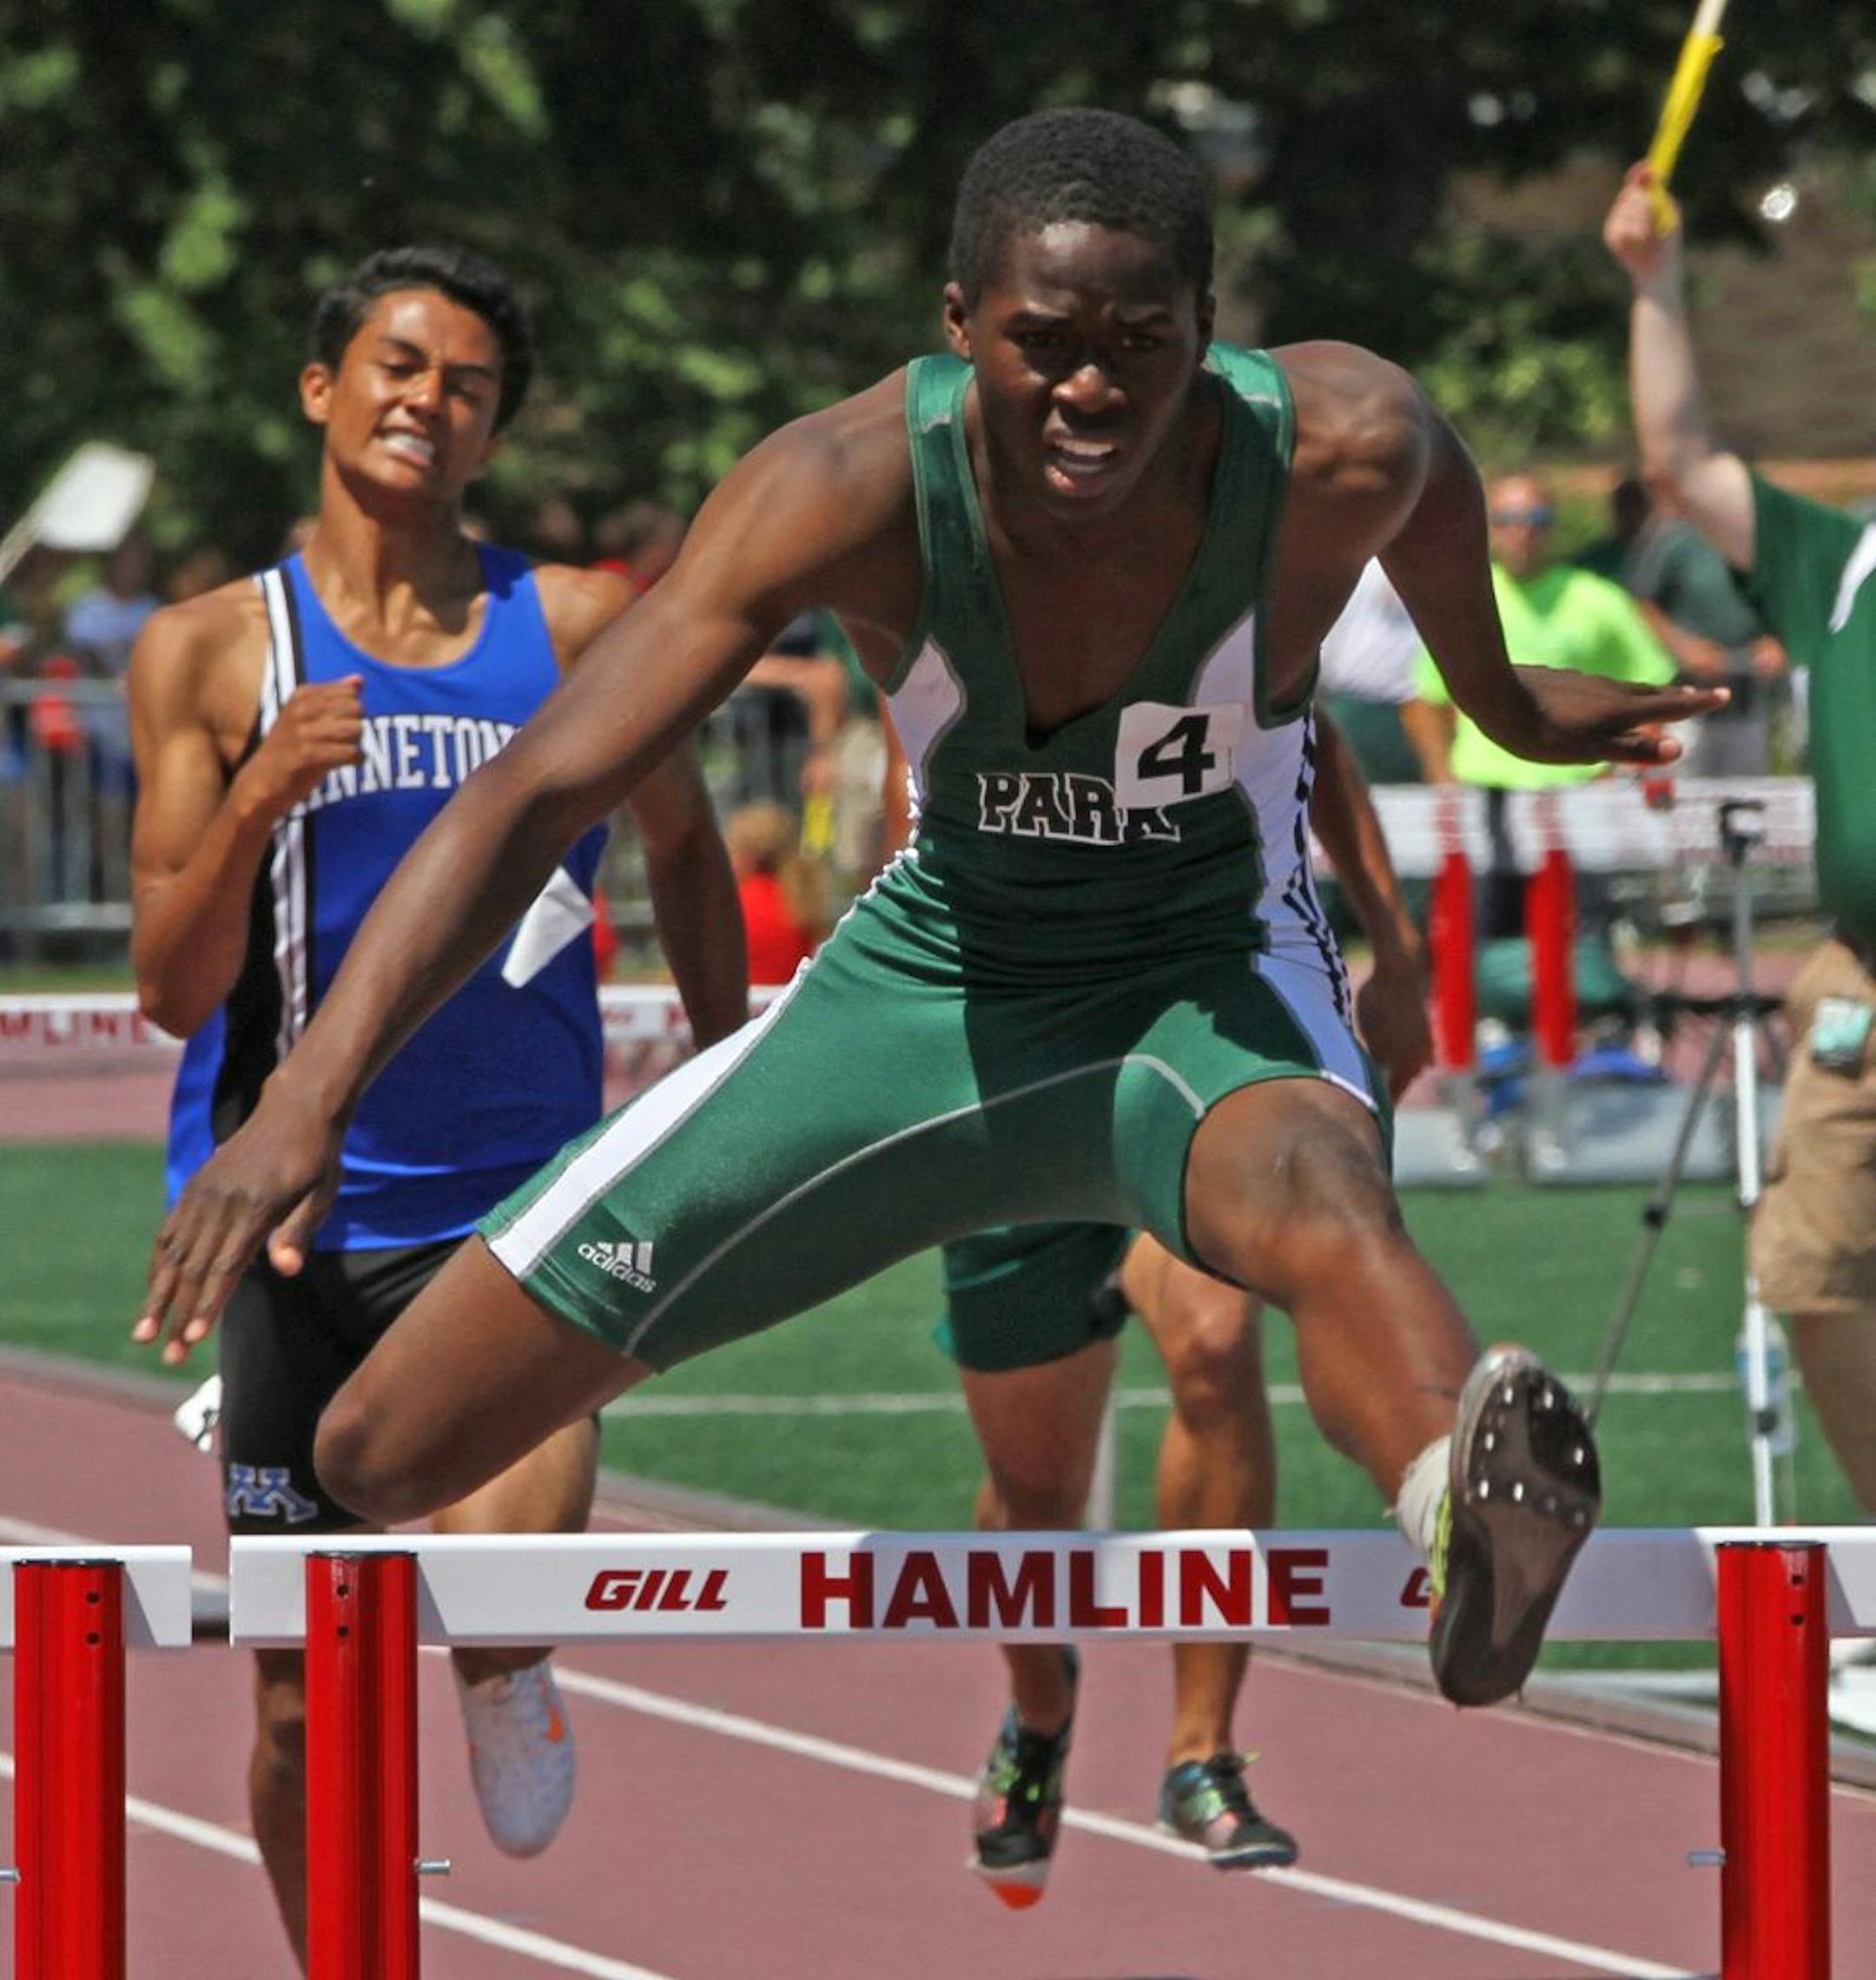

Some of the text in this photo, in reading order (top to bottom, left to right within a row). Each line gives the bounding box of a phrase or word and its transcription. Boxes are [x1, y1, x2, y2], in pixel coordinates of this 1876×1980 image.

[1137, 713, 1215, 795] 4
[578, 1243, 657, 1293] adidas
[585, 1569, 729, 1610] GILL
[801, 1550, 1331, 1628] HAMLINE
